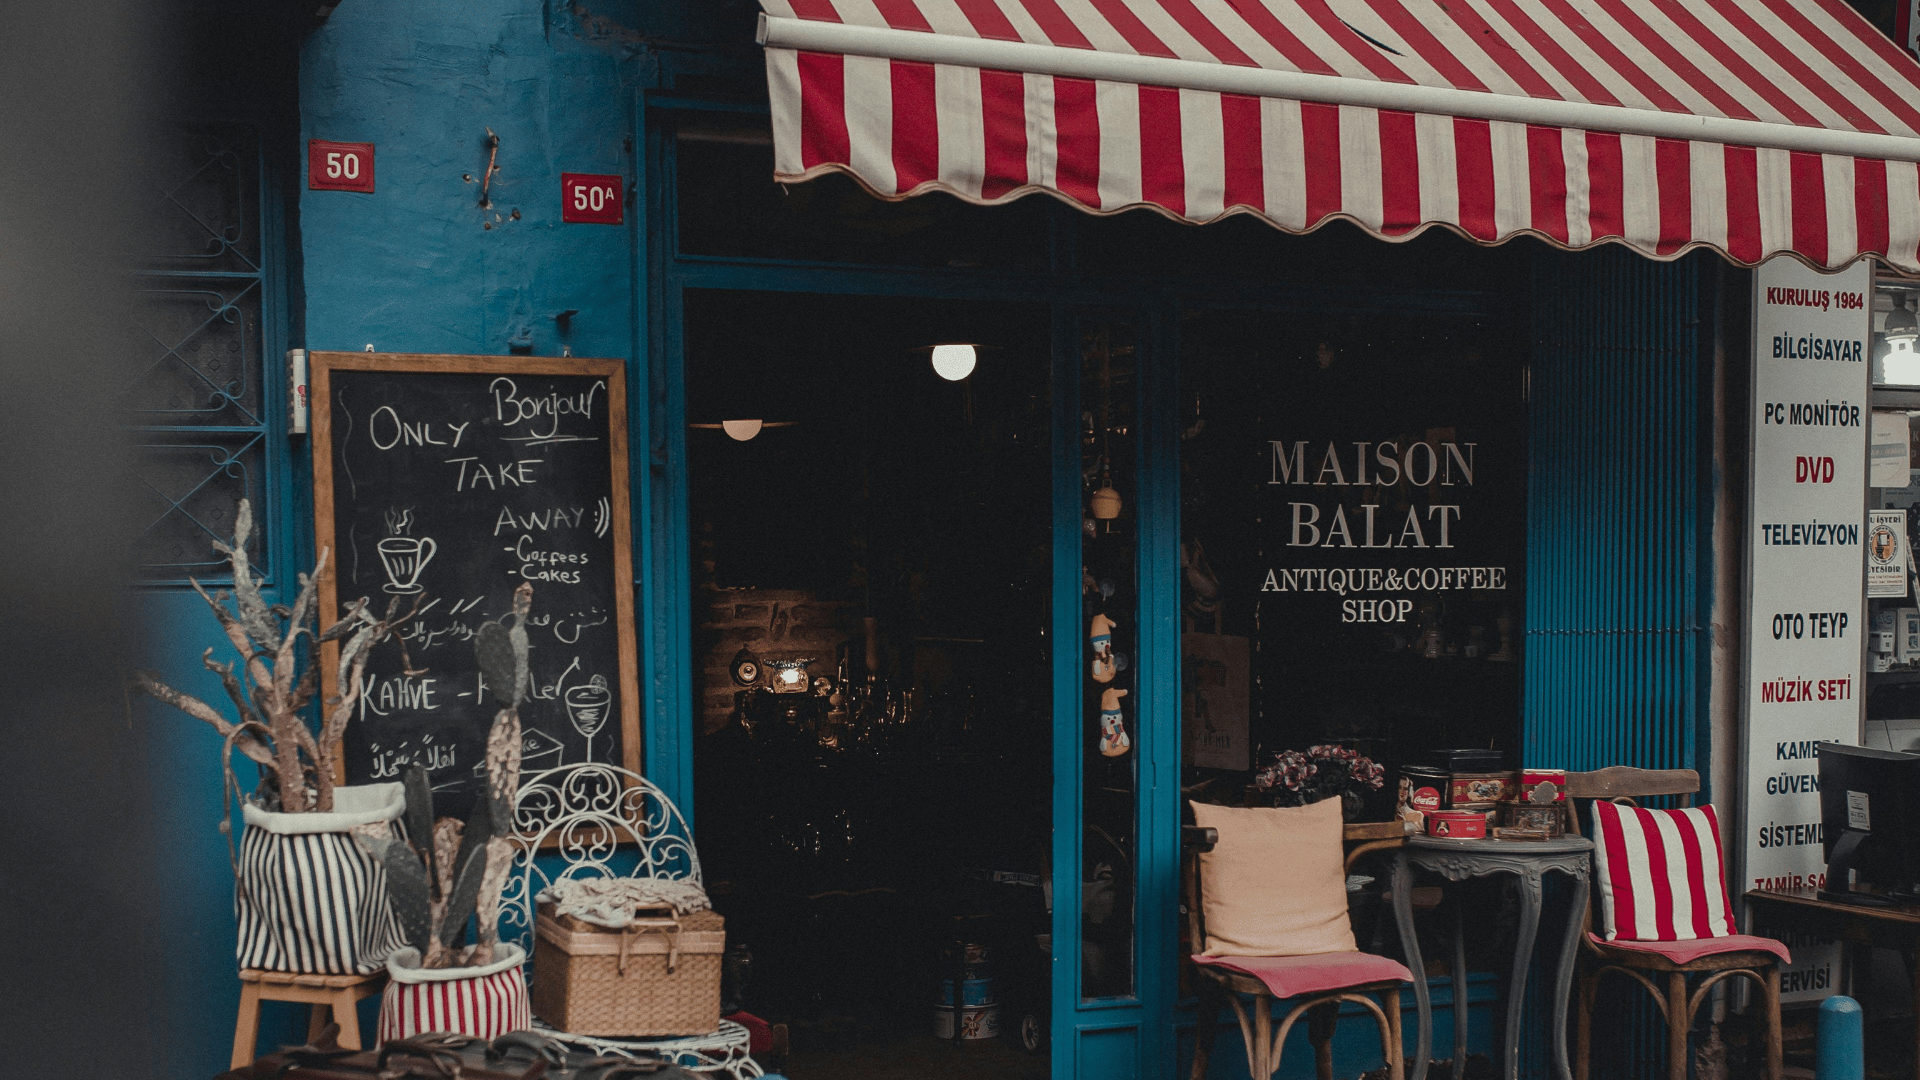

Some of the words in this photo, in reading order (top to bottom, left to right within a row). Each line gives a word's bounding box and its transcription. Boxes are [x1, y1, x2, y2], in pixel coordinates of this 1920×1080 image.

[326, 152, 360, 180] 50
[1766, 286, 1830, 312] KURULUŞ
[1833, 290, 1864, 310] 1984
[1772, 331, 1863, 362] BİLGİSAYAR
[490, 377, 606, 438] Bonjour
[1764, 402, 1785, 425] PC
[1789, 399, 1860, 427] MONİTÖR
[370, 405, 469, 450] ONLY
[444, 457, 544, 491] TAKE
[1267, 440, 1477, 487] MAISON
[1795, 456, 1835, 484] DVD
[494, 505, 584, 536] AWAY
[1286, 502, 1461, 549] BALAT
[1761, 519, 1858, 546] TELEVİZYON
[1261, 567, 1507, 596] ANTIQUE&COFFEE
[1342, 599, 1413, 623] SHOP
[1772, 613, 1804, 640] OTO
[1808, 612, 1848, 639] TEYP
[360, 673, 441, 721] KAHVE
[1761, 675, 1813, 703] MÜZİK
[1817, 673, 1851, 700] SETİ
[1776, 740, 1839, 761] KAME
[1766, 772, 1820, 796] GÜVEN
[1758, 821, 1824, 848] SİSTEML
[1754, 871, 1826, 891] TAMİR-SA
[1780, 962, 1831, 994] ERVİSİ
